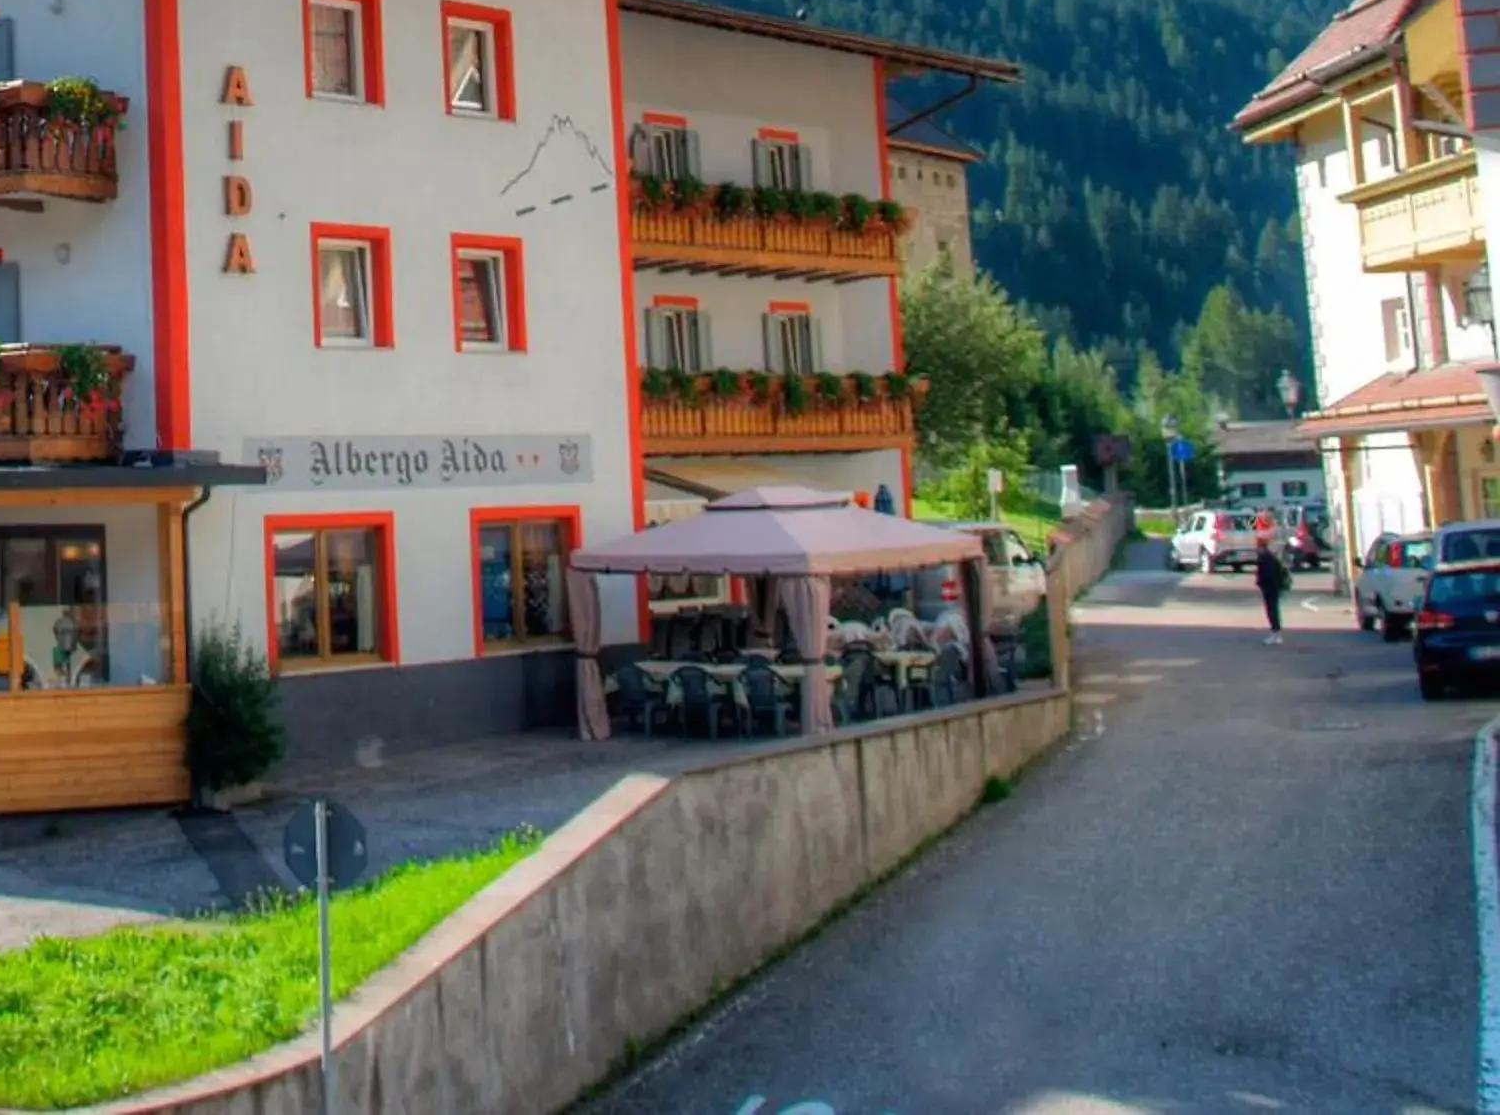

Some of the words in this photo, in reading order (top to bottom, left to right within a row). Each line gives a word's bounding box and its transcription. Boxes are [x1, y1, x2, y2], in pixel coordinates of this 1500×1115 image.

[217, 65, 256, 274] AIDA
[309, 440, 429, 485] Albergo
[440, 437, 507, 482] Aida
